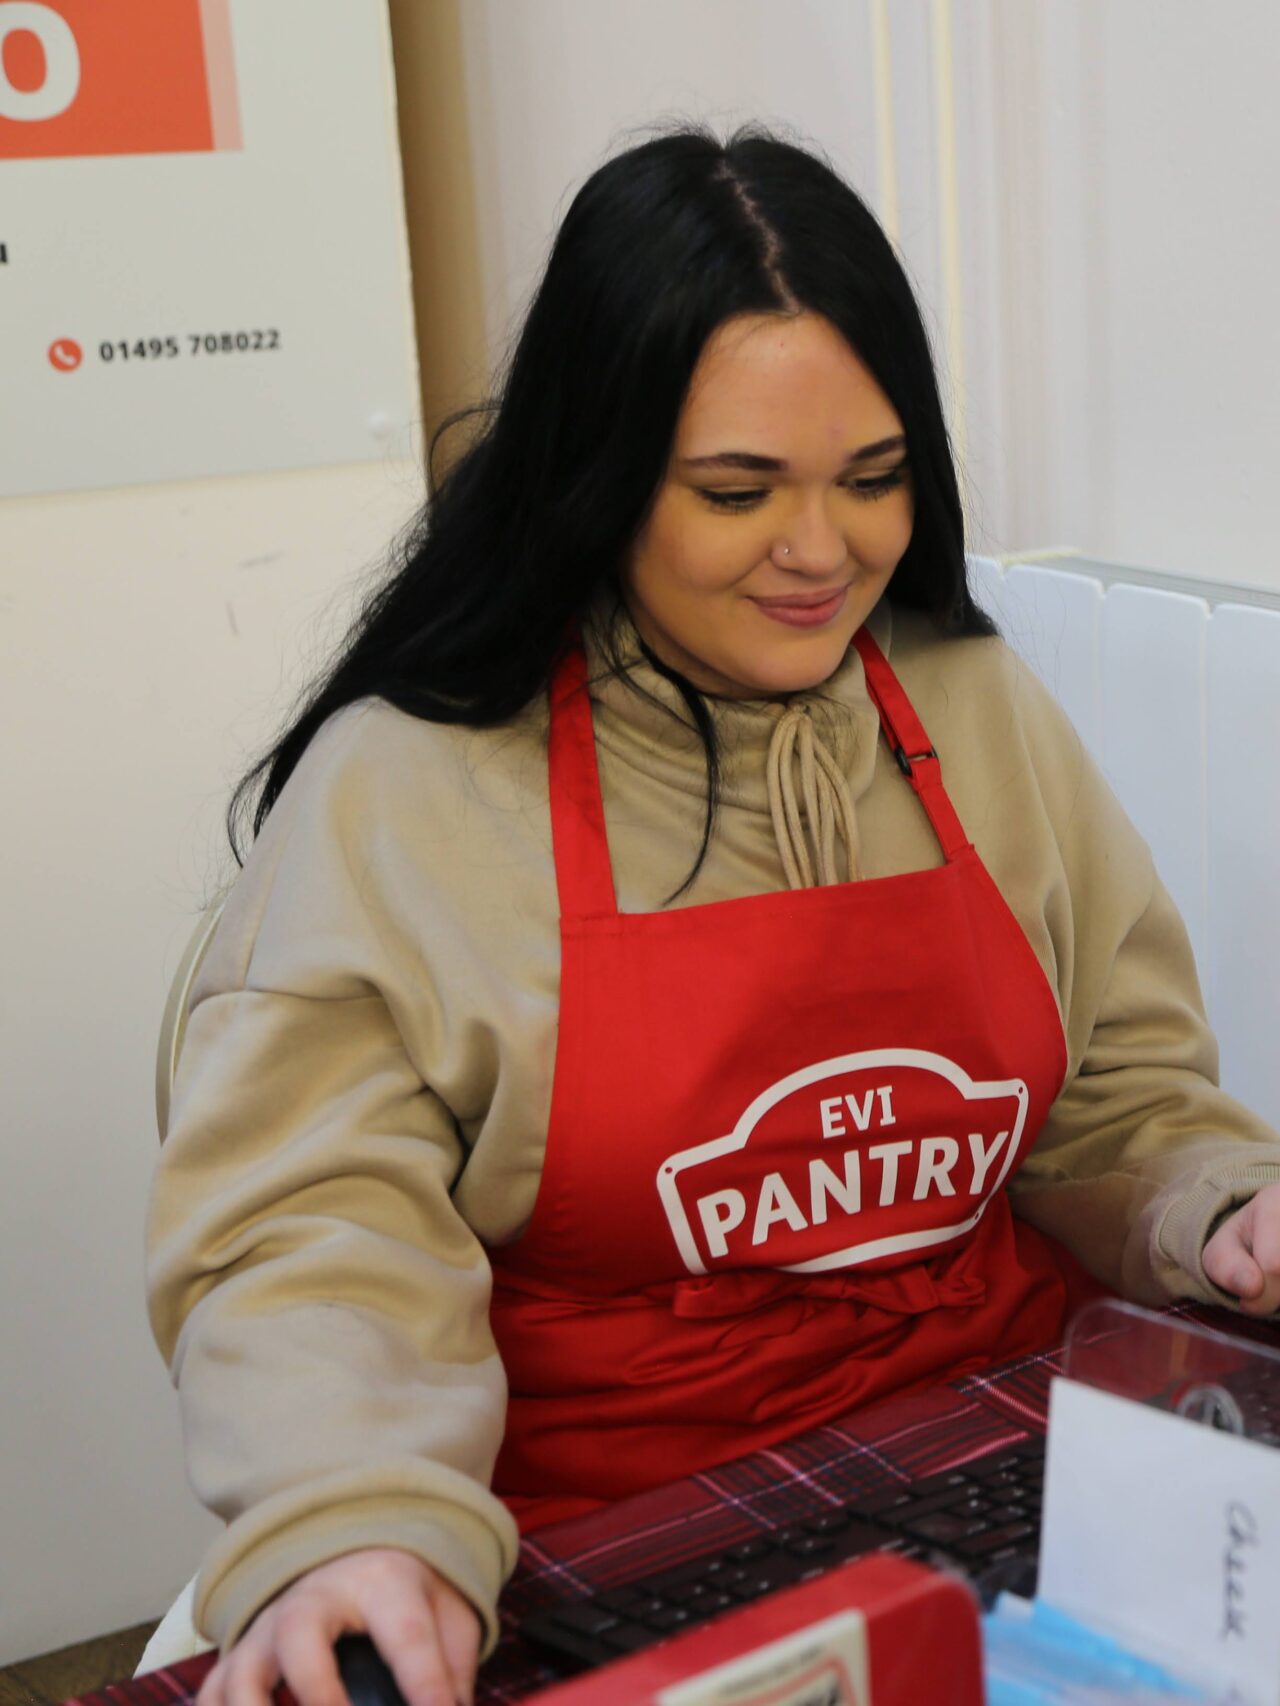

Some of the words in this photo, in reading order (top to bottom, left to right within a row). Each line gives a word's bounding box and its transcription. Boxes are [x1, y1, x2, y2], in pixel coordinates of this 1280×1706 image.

[99, 337, 179, 362] 01495
[188, 329, 280, 356] 708022
[820, 1085, 896, 1139] EVI
[696, 1131, 1009, 1258] PANTRY
